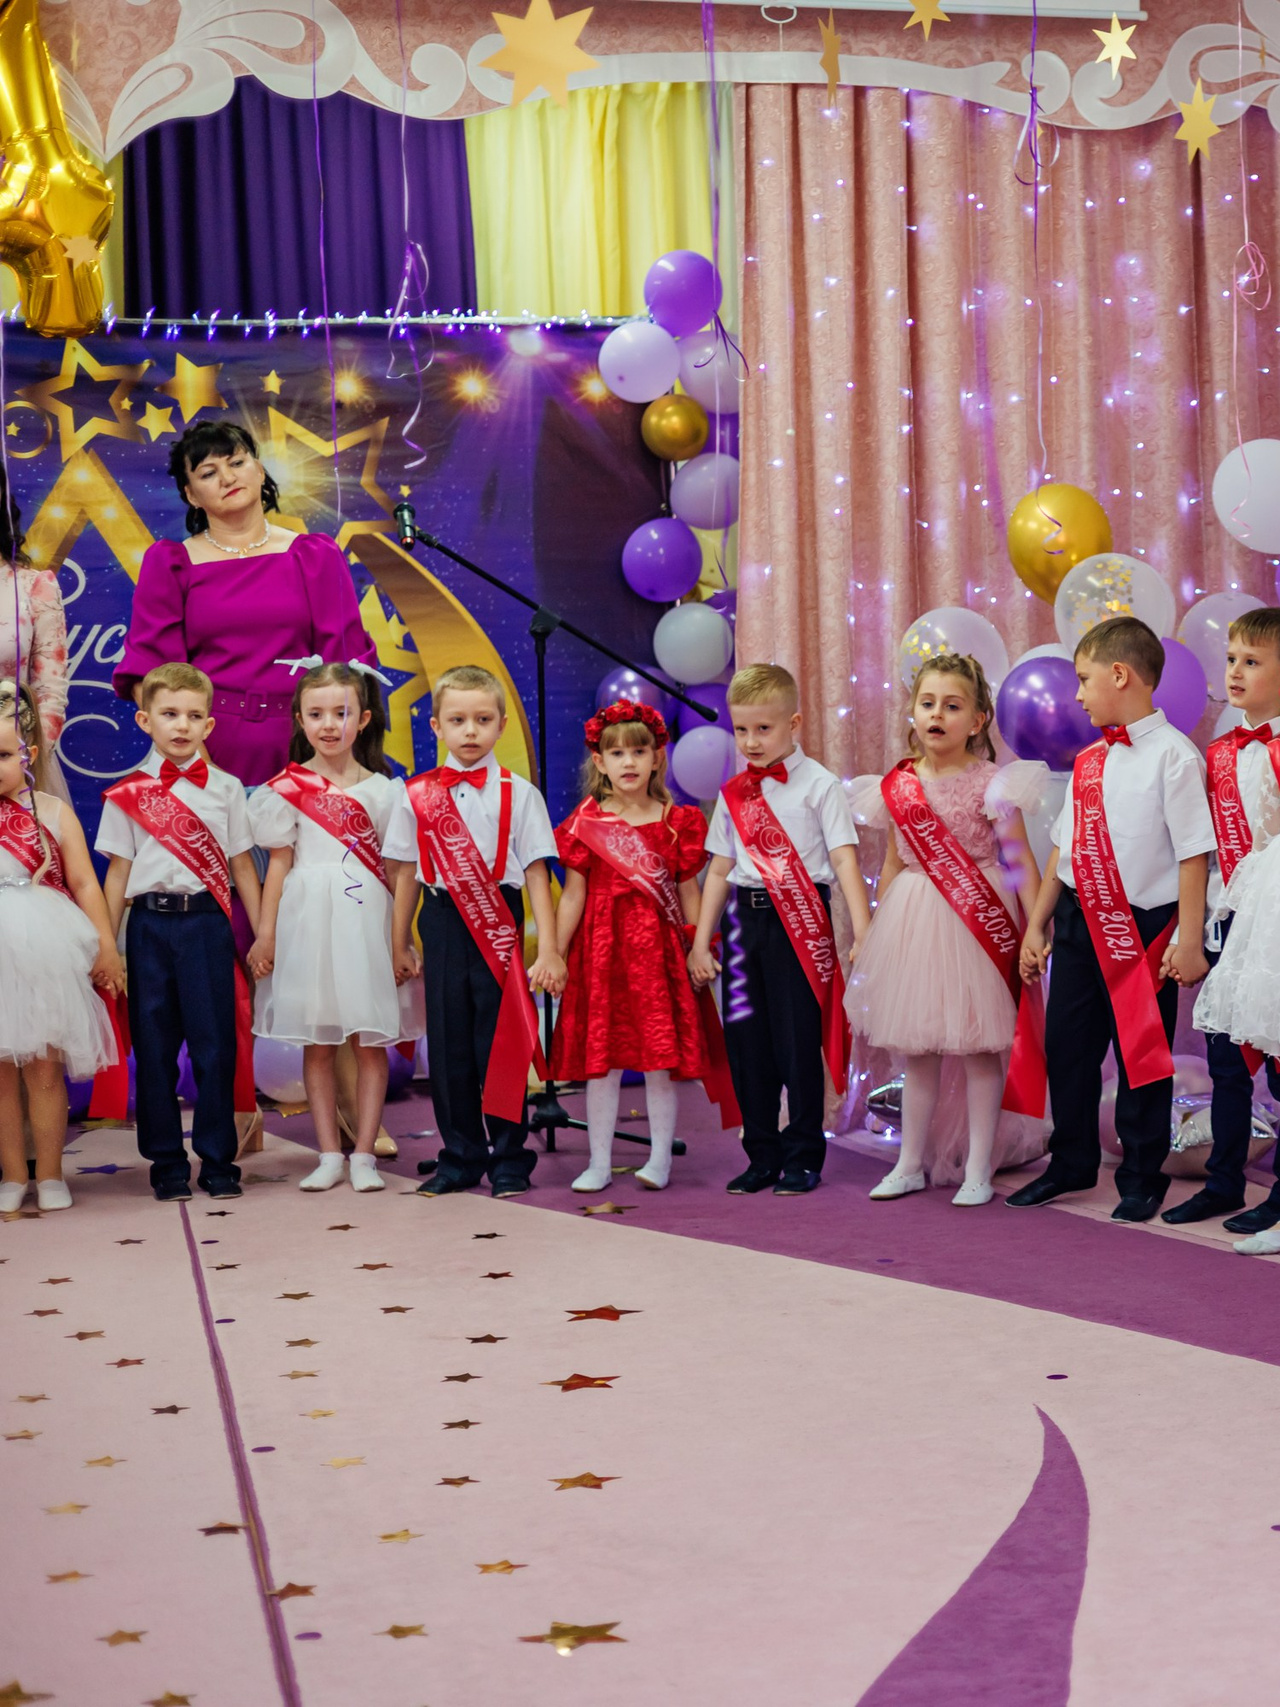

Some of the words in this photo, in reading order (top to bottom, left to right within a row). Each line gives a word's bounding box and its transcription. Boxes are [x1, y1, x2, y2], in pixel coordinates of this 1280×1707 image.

[438, 813, 500, 926] Выпускник
[901, 824, 928, 861] детского
[926, 856, 943, 881] сада
[1083, 784, 1114, 908] Выпускник
[446, 869, 461, 893] сада
[908, 801, 989, 911] Выпускница
[975, 906, 1016, 954] 2024
[805, 936, 835, 984] 2024
[1097, 910, 1138, 961] 2024
